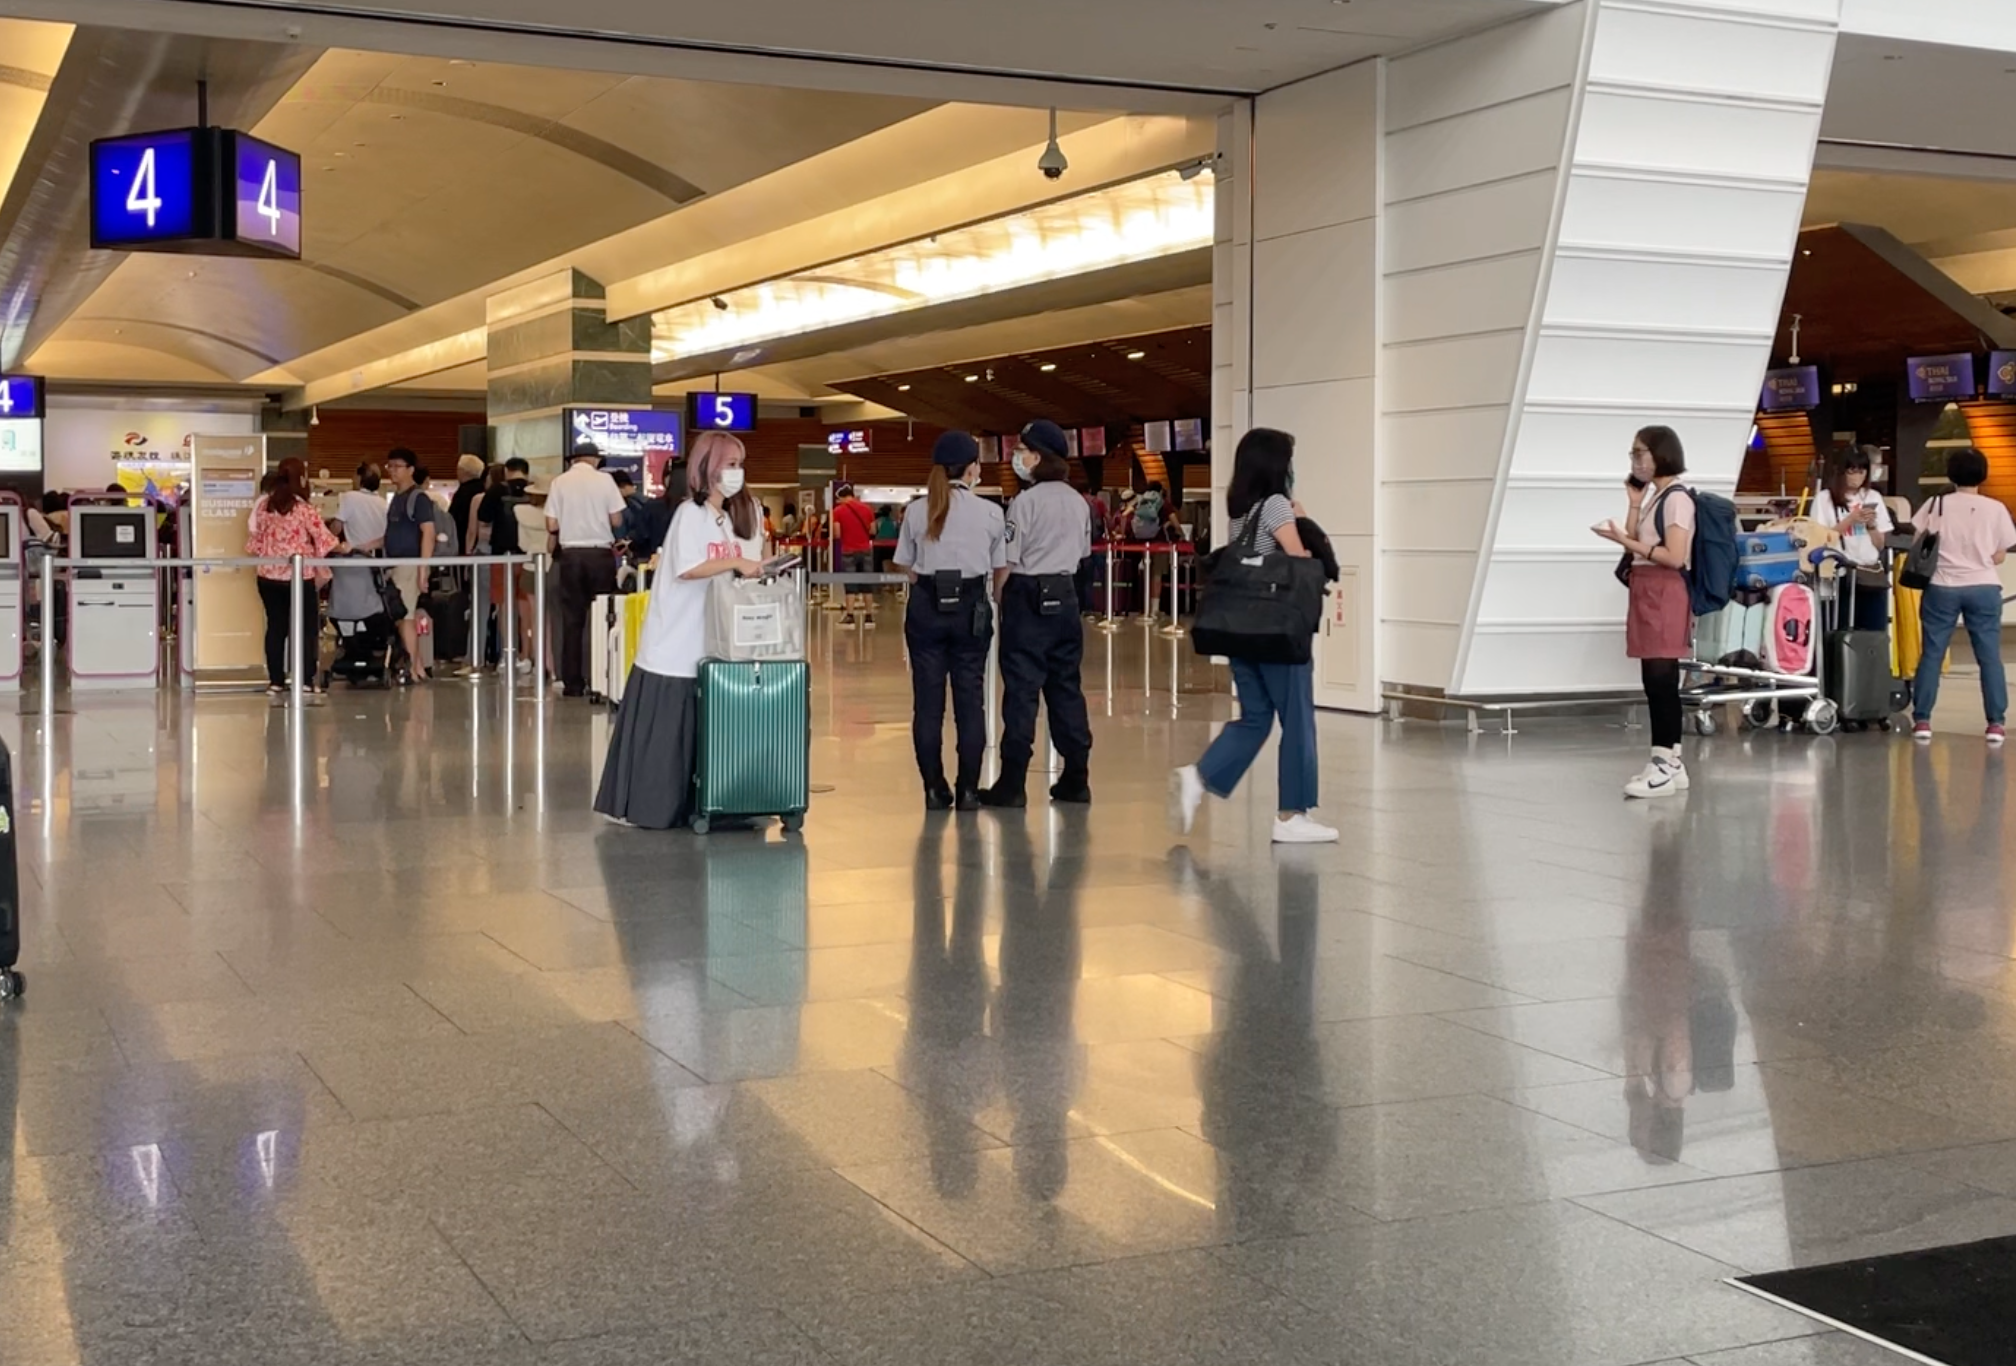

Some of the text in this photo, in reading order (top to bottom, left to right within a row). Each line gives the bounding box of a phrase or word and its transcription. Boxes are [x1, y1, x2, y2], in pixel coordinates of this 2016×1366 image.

[126, 148, 162, 226] 4
[257, 159, 281, 235] 4
[1926, 366, 1949, 376] THAI
[0, 379, 14, 413] 4
[715, 396, 734, 426] 5
[201, 500, 254, 509] BUSINESS
[201, 509, 237, 518] CLASS
